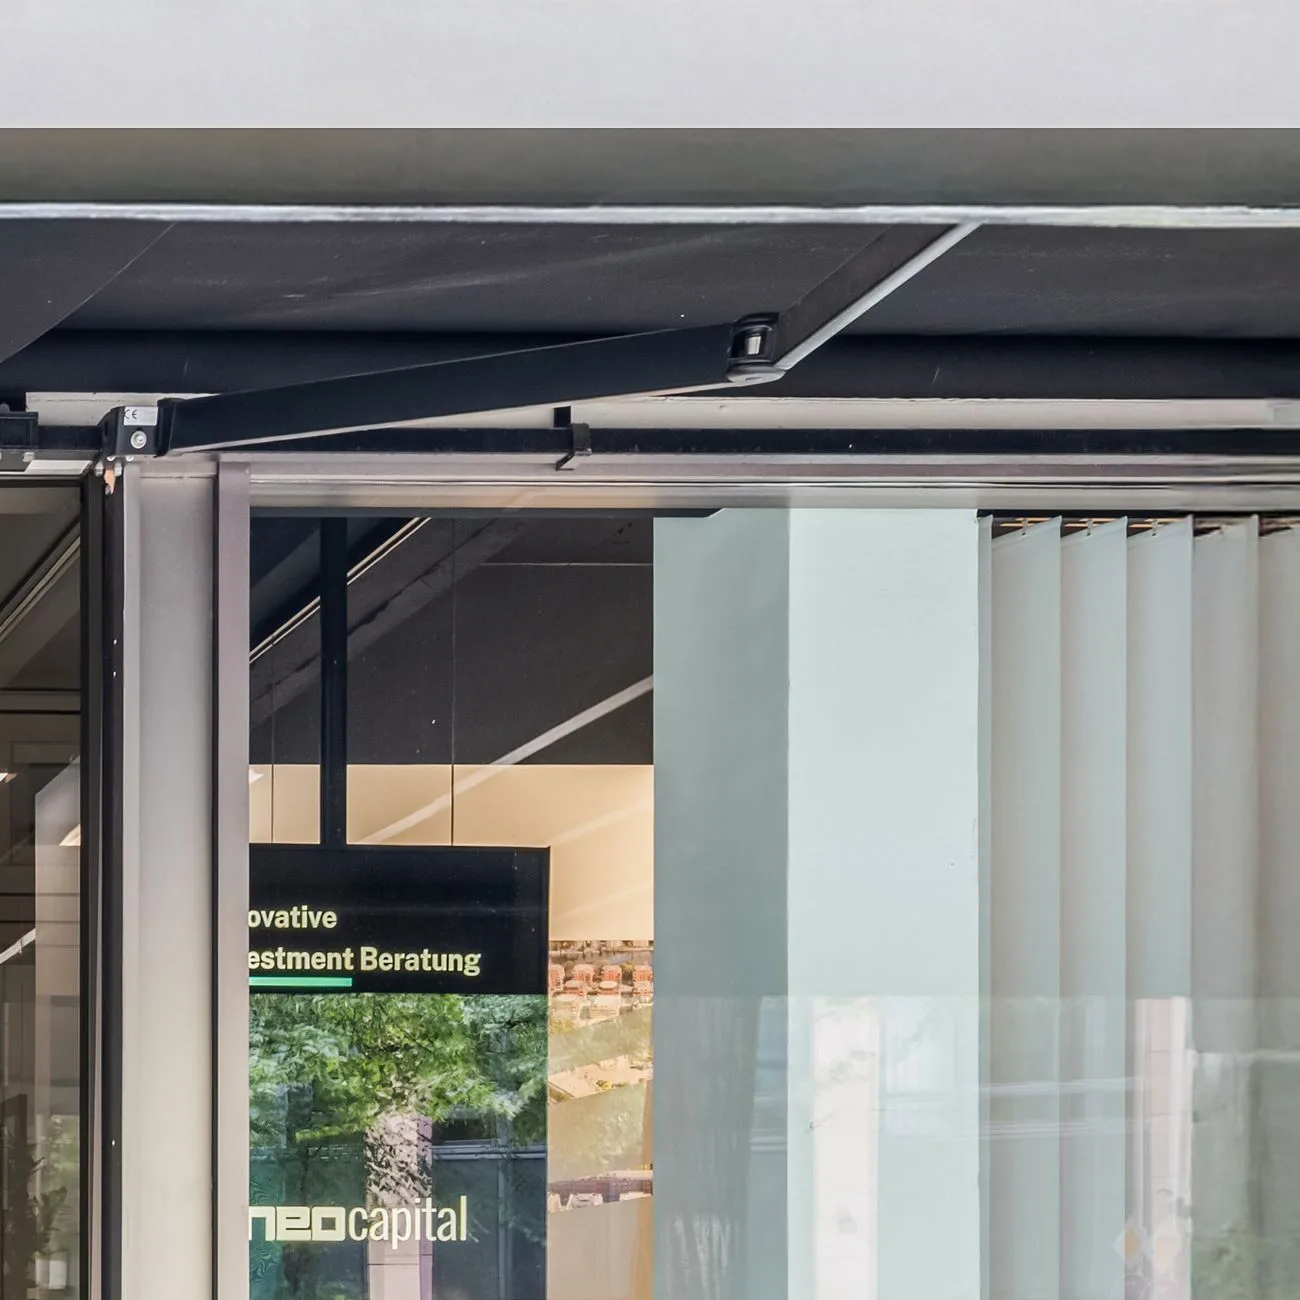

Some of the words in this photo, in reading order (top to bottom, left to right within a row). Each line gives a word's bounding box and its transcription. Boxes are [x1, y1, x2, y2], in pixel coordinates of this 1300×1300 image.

[248, 905, 338, 929] ovative
[248, 947, 355, 970] estment
[359, 946, 482, 976] Beratung
[248, 1196, 467, 1250] neocapital
